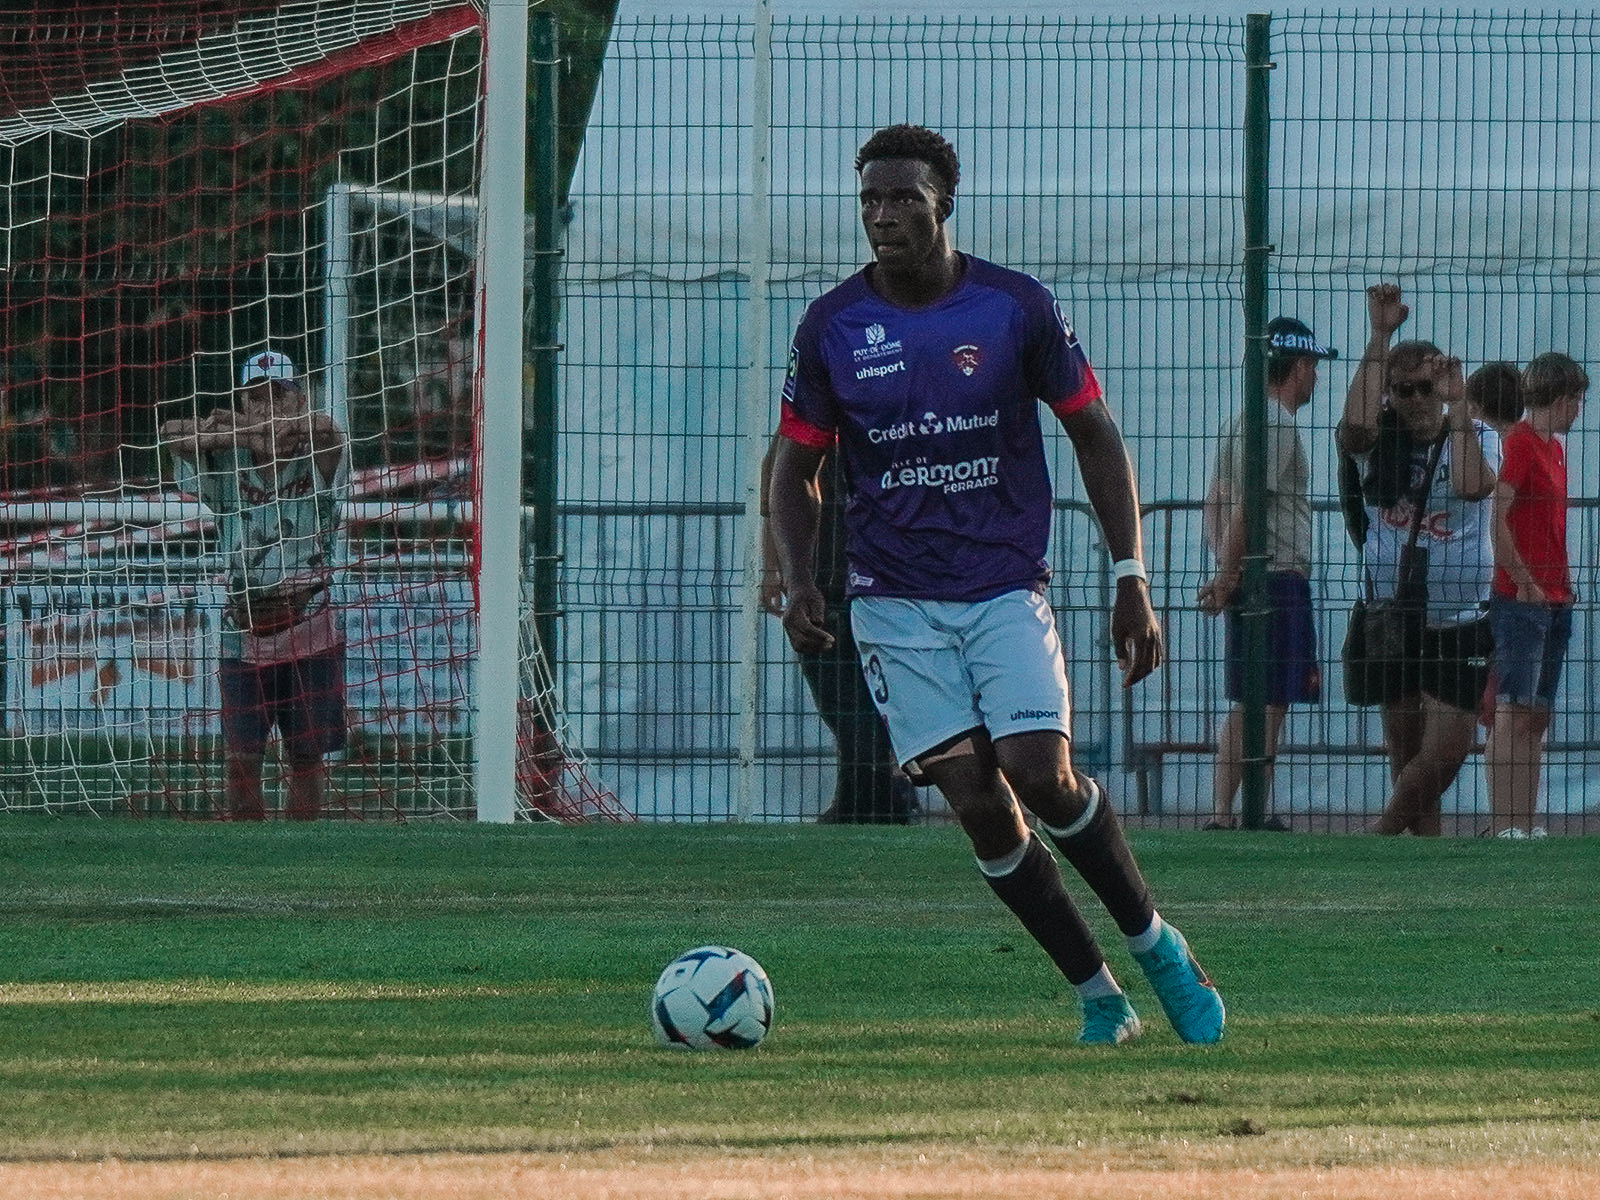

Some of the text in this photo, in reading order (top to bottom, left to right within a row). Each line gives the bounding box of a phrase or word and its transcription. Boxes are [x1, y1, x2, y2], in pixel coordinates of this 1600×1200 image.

[855, 360, 906, 380] uhlsport
[868, 409, 999, 444] Crédit Mutuel
